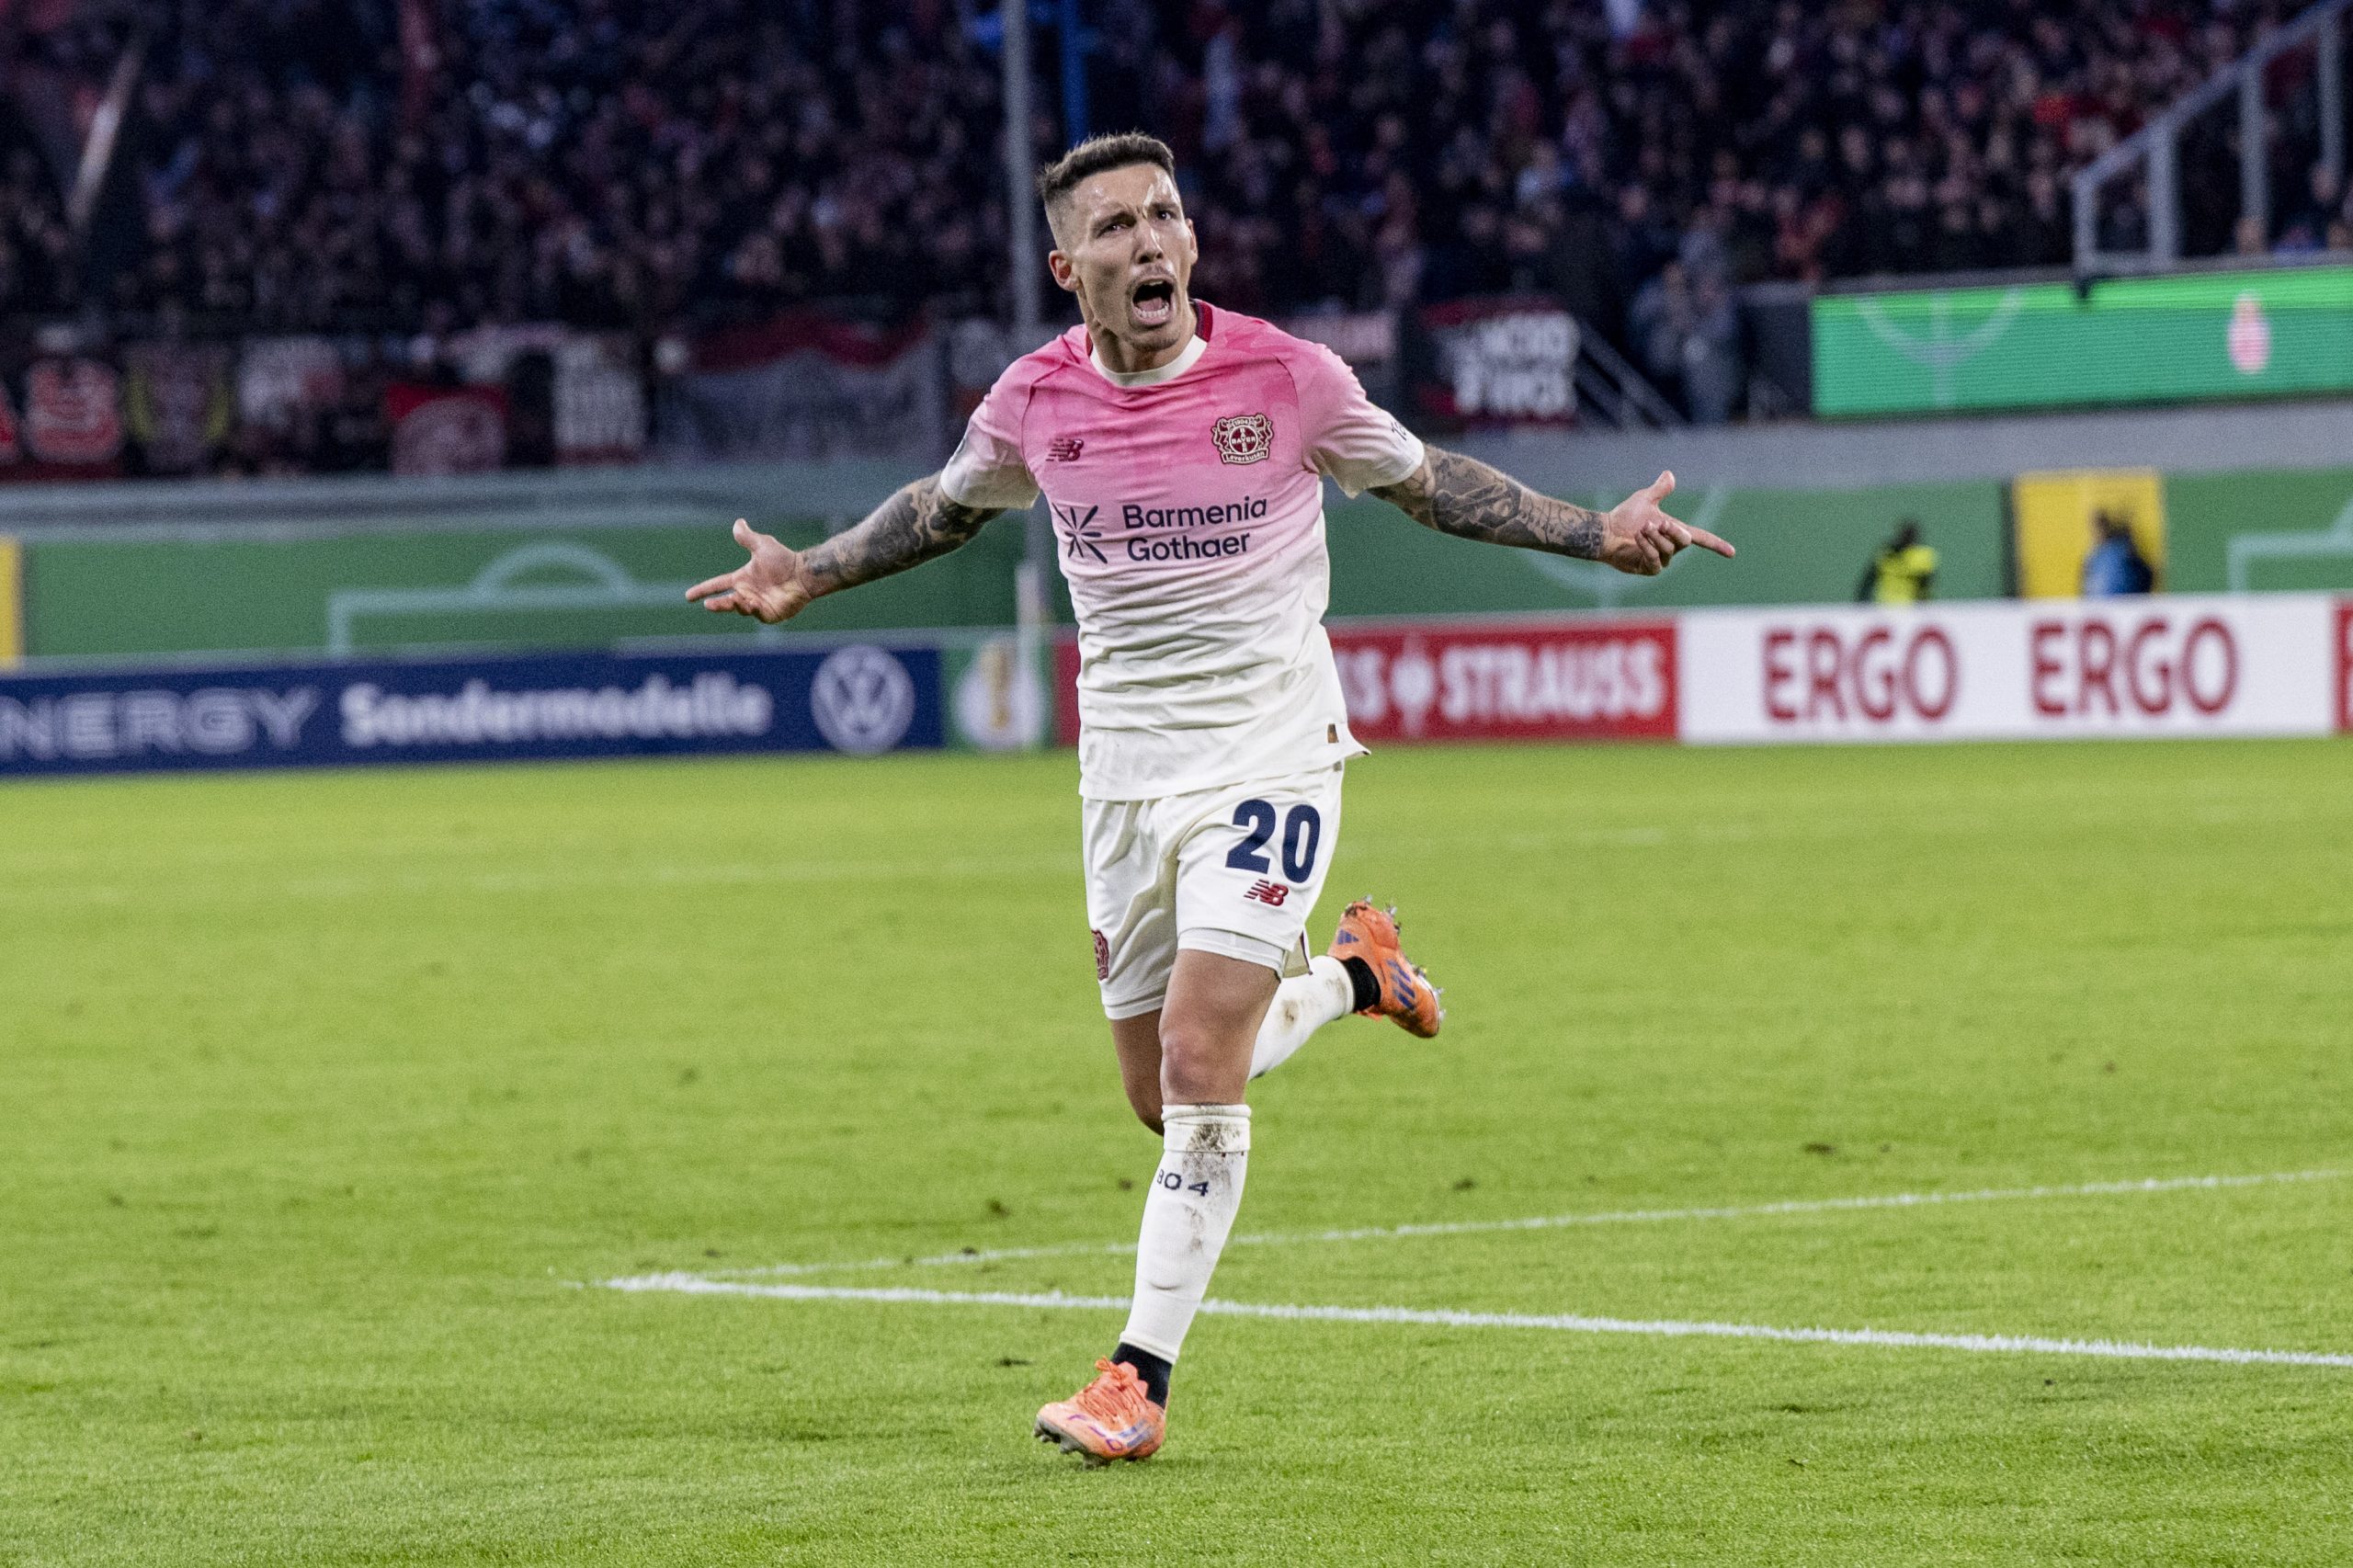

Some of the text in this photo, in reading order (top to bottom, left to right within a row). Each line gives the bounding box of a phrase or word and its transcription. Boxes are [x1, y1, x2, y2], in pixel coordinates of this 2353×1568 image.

[1225, 450, 1266, 462] Leverkusen
[1122, 495, 1267, 529] Barmenia
[1127, 532, 1251, 562] Gothaer
[1440, 640, 1666, 722] STRAUSS
[1764, 627, 1957, 722] ERGO
[2030, 619, 2240, 717] ERGO
[0, 689, 317, 759] NERGY
[1225, 799, 1321, 883] 20
